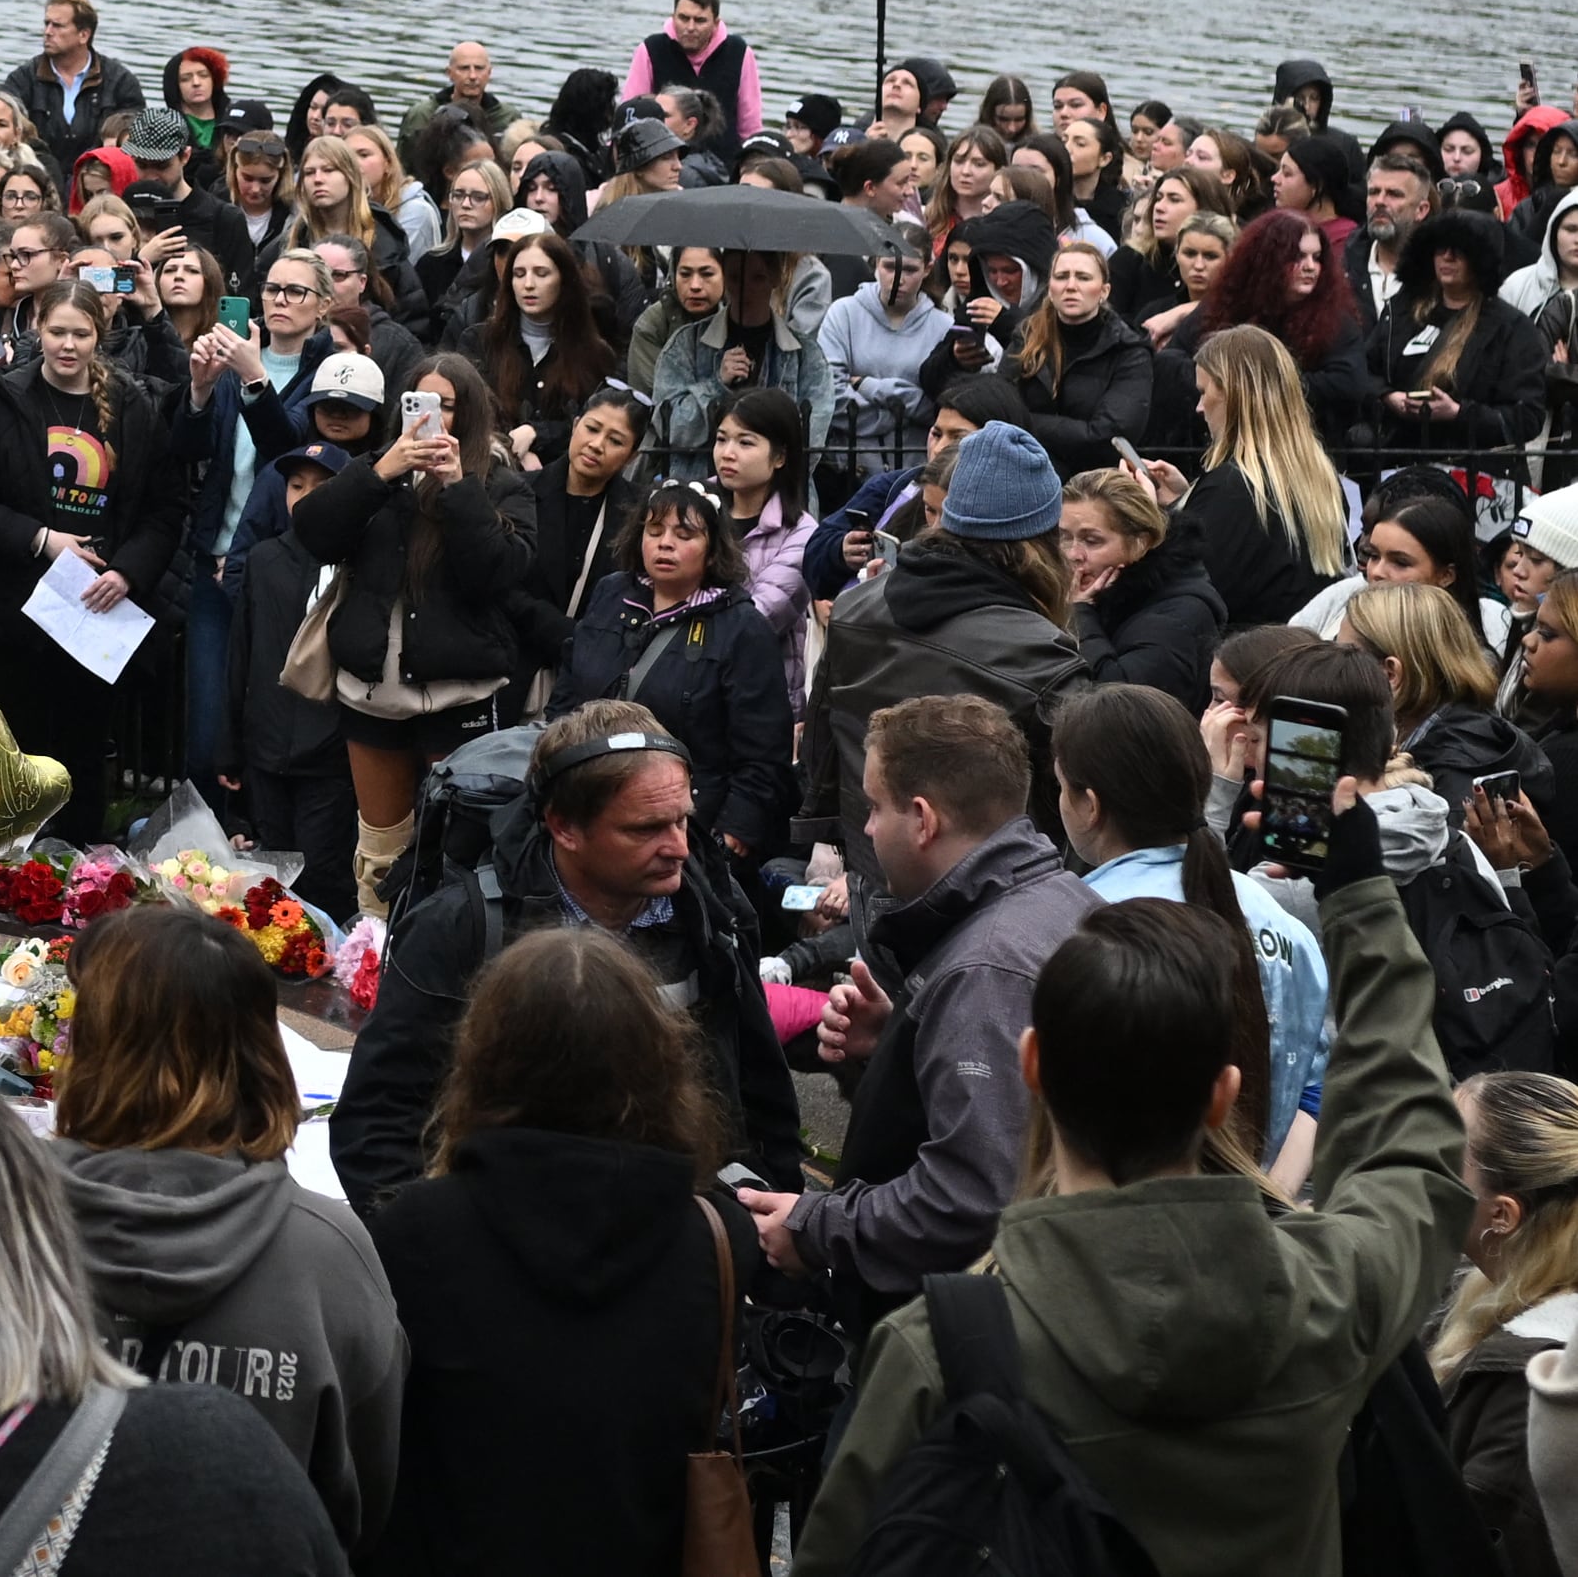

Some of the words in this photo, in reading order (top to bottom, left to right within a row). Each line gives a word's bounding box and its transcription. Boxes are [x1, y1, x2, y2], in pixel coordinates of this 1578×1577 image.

[69, 489, 108, 507] TOUR
[461, 720, 488, 729] adidas
[1255, 928, 1293, 967] OW
[275, 1350, 298, 1402] 2023
